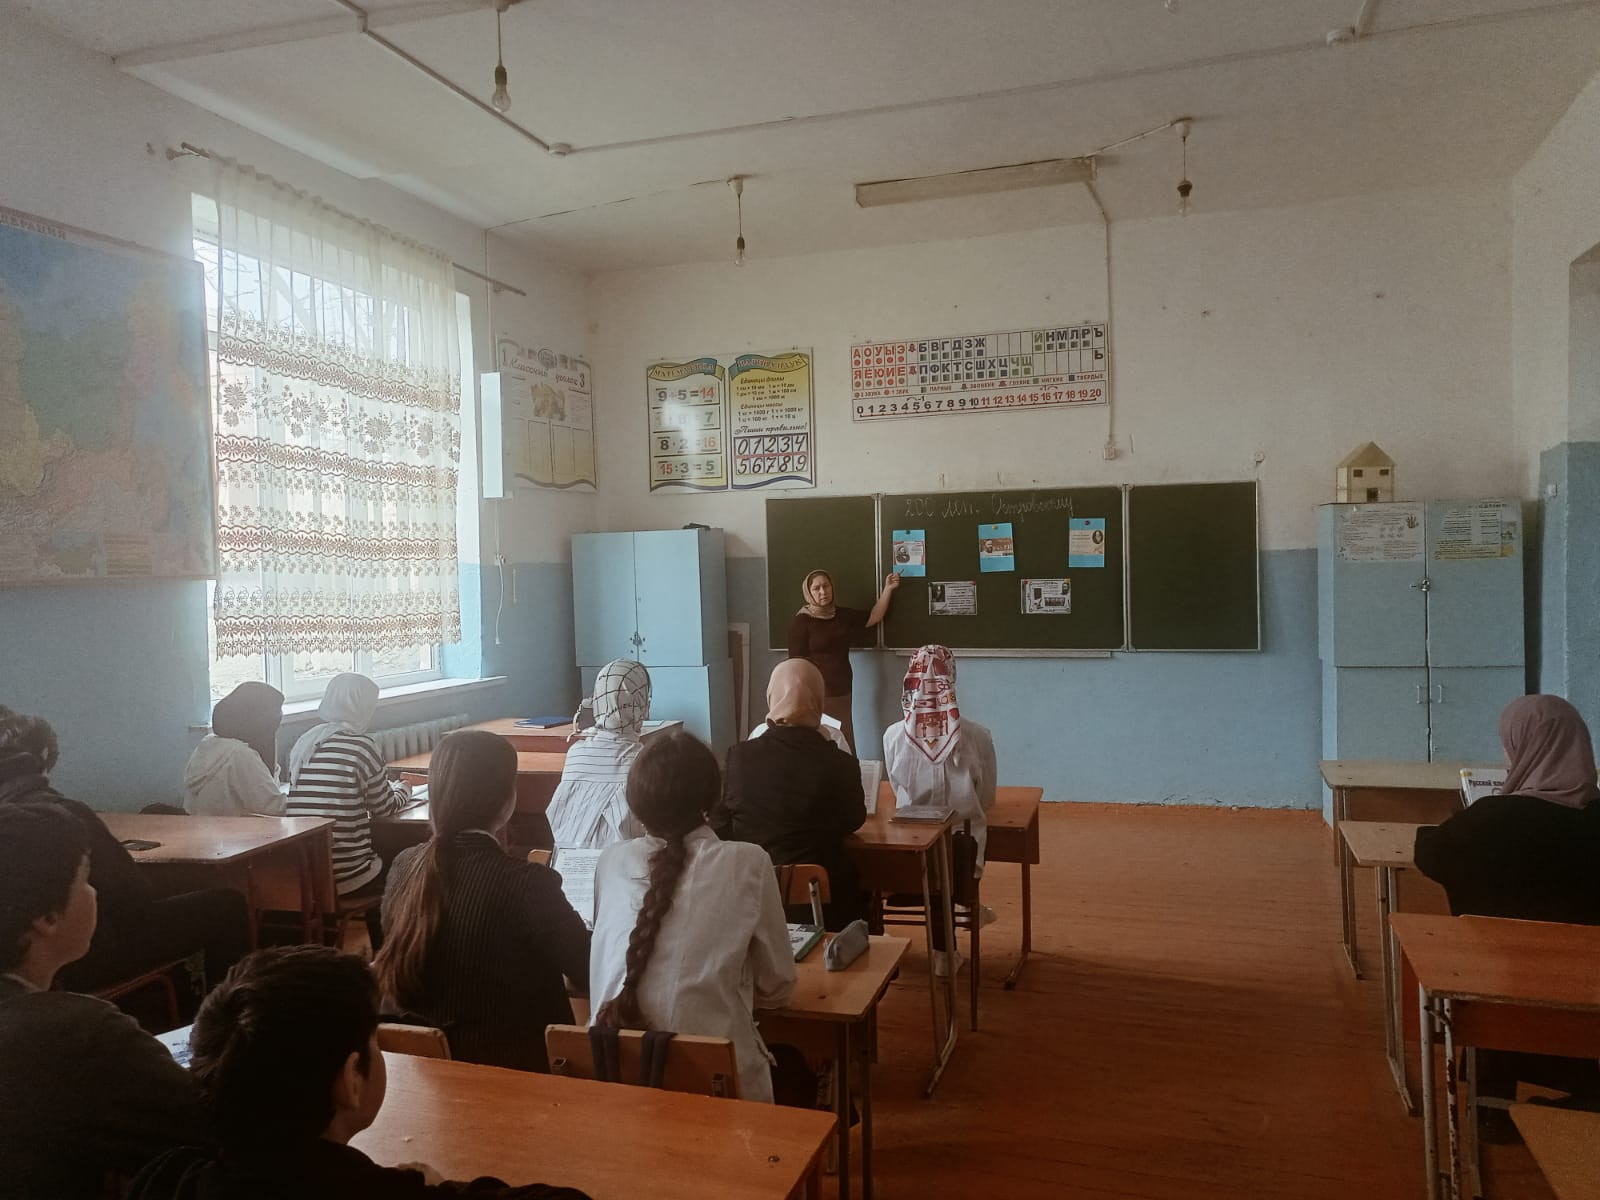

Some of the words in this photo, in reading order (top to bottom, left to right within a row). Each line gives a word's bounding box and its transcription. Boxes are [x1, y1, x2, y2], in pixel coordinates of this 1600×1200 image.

[854, 349, 860, 358] А
[864, 348, 872, 357] О
[875, 346, 882, 356] У
[885, 346, 894, 355] Ы
[897, 344, 905, 354] Э
[919, 343, 927, 352] Б
[931, 342, 939, 351] В
[942, 341, 949, 350] Г
[952, 340, 962, 350] Д
[964, 339, 972, 348] З
[975, 338, 985, 348] Ж
[1034, 332, 1042, 342] Й
[1046, 332, 1054, 341] Н
[1057, 331, 1067, 340] М
[1070, 330, 1078, 340] Л
[1082, 329, 1090, 338] Р
[1094, 328, 1103, 337] Ъ
[854, 370, 862, 379] Я
[864, 367, 872, 378] Ё
[874, 368, 884, 378] Ю
[886, 368, 895, 377] И
[898, 367, 905, 376] Е
[920, 365, 928, 374] П
[930, 364, 939, 373] Ф
[942, 363, 950, 372] К
[953, 362, 961, 372] Т
[965, 361, 973, 371] С
[976, 360, 985, 370] Ш
[988, 359, 996, 368] Х
[999, 359, 1008, 368] Ц
[1011, 357, 1019, 366] Ч
[1022, 356, 1032, 367] Щ
[1094, 350, 1103, 360] Ь
[658, 391, 667, 402] 9
[678, 390, 687, 400] 5
[700, 387, 715, 399] 14
[857, 406, 863, 414] 0
[913, 402, 920, 410] 5
[924, 401, 931, 409] 6
[969, 398, 979, 406] 10
[982, 397, 990, 405] 11
[1078, 390, 1087, 398] 19
[1090, 389, 1101, 397] 20
[705, 412, 714, 423] 7
[660, 440, 669, 450] 8
[680, 438, 688, 449] 2
[704, 437, 716, 447] 16
[738, 439, 748, 454] 0
[752, 437, 761, 454] 1
[764, 437, 777, 454] 2
[779, 437, 790, 452] 3
[795, 436, 805, 451] 4
[660, 464, 672, 474] 15
[680, 462, 689, 474] 3
[706, 460, 714, 471] 5
[738, 458, 750, 474] 5
[752, 457, 762, 472] 6
[765, 457, 776, 473] 7
[779, 456, 790, 472] 8
[797, 455, 806, 471] 9
